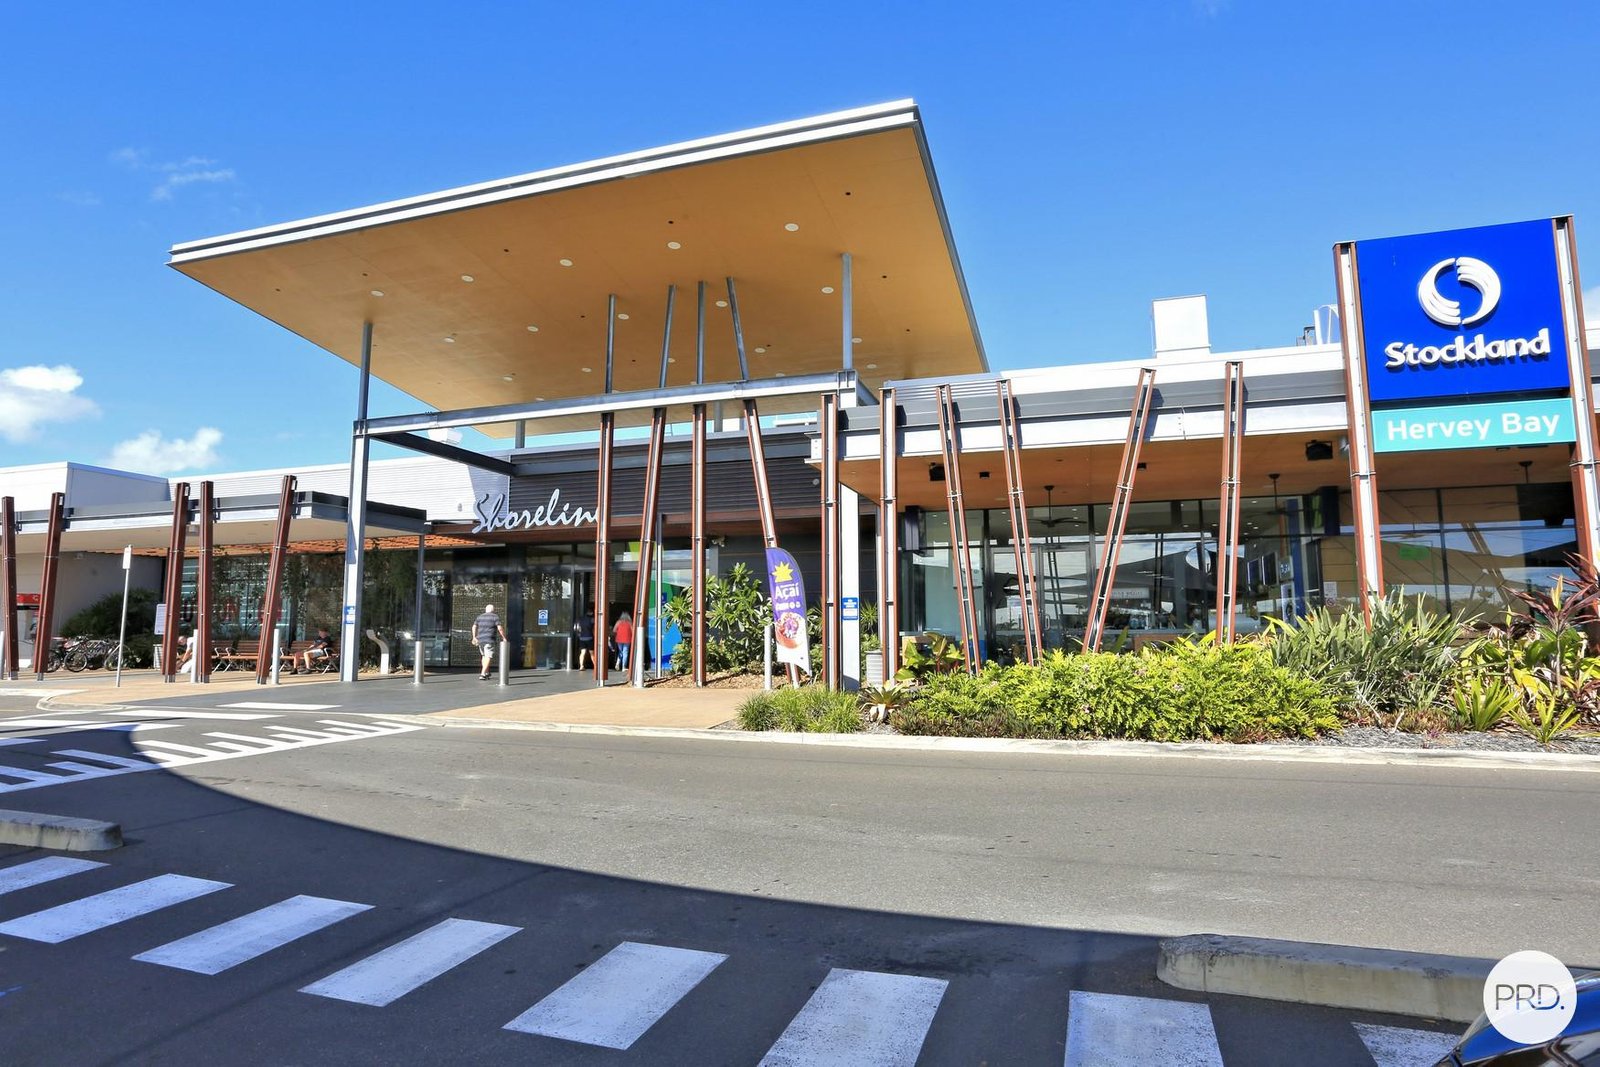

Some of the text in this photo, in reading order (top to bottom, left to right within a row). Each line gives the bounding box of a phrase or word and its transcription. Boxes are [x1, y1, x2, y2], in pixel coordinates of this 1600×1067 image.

[1385, 328, 1551, 367] Stockland
[1387, 412, 1560, 440] Hervey Bay
